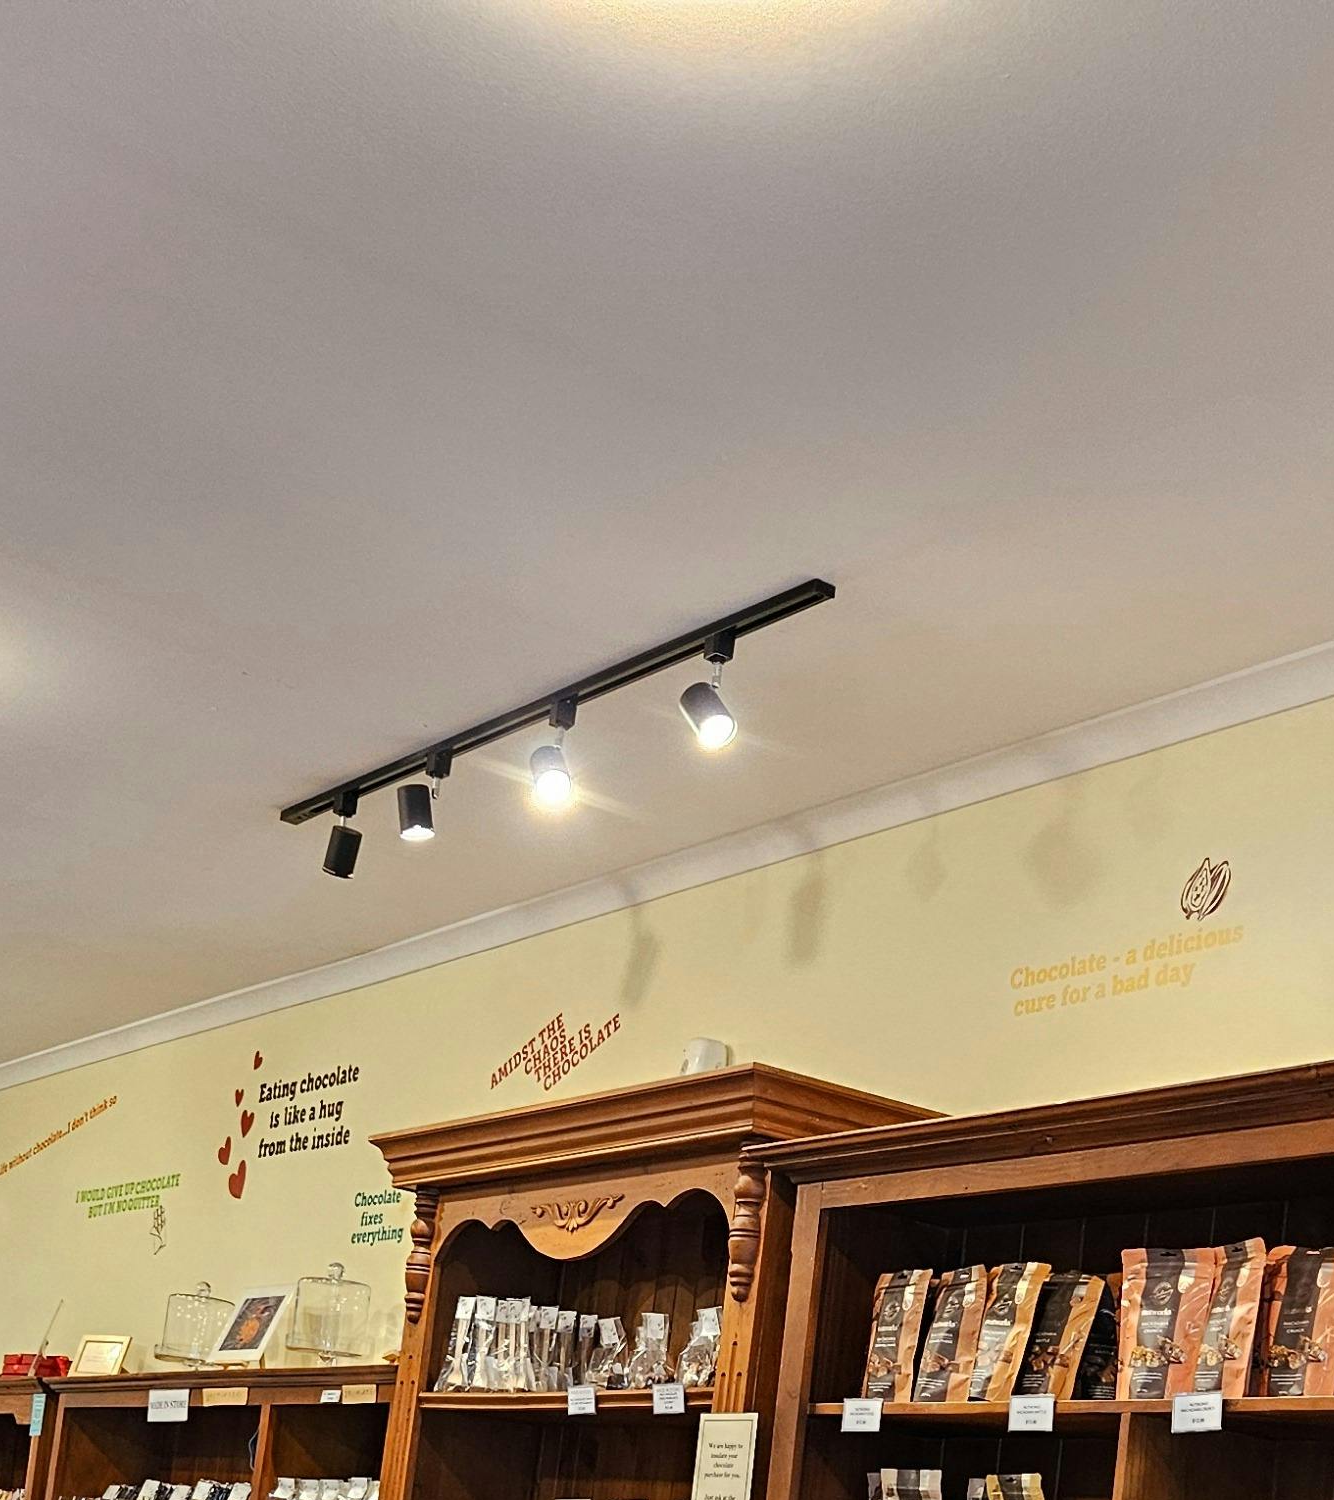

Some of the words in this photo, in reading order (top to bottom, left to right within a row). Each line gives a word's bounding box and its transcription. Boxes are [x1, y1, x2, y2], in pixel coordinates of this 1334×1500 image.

[1010, 953, 1107, 991] Chocolate
[1125, 947, 1138, 967] a
[1143, 923, 1245, 963] delicious
[1013, 995, 1057, 1018] cure
[1060, 983, 1092, 1008] for
[1095, 981, 1107, 1001] a
[1112, 969, 1150, 998] bad
[1155, 960, 1197, 988] day
[490, 1036, 537, 1091] AMIDST
[538, 1012, 565, 1045] THE
[524, 1028, 567, 1076] CHAOS
[534, 1036, 577, 1083] THERE
[578, 1023, 593, 1045] IS
[543, 1013, 622, 1092] CHOCOLATE
[259, 1079, 299, 1104] Eating
[299, 1064, 361, 1095] chocolate
[270, 1111, 280, 1130] is
[284, 1104, 306, 1127] like
[309, 1108, 316, 1122] a
[319, 1099, 345, 1122] hug
[9, 1147, 33, 1171] without
[258, 1137, 287, 1159] from
[290, 1132, 309, 1153] the
[312, 1125, 351, 1151] inside
[81, 1187, 105, 1202] WOULD
[107, 1183, 124, 1200] GIVE
[125, 1181, 135, 1196] UP
[136, 1173, 182, 1195] CHOCOLATE
[354, 1188, 403, 1208] Chocolate
[88, 1204, 102, 1219] BUT
[361, 1211, 384, 1227] fixes
[351, 1226, 405, 1247] everything
